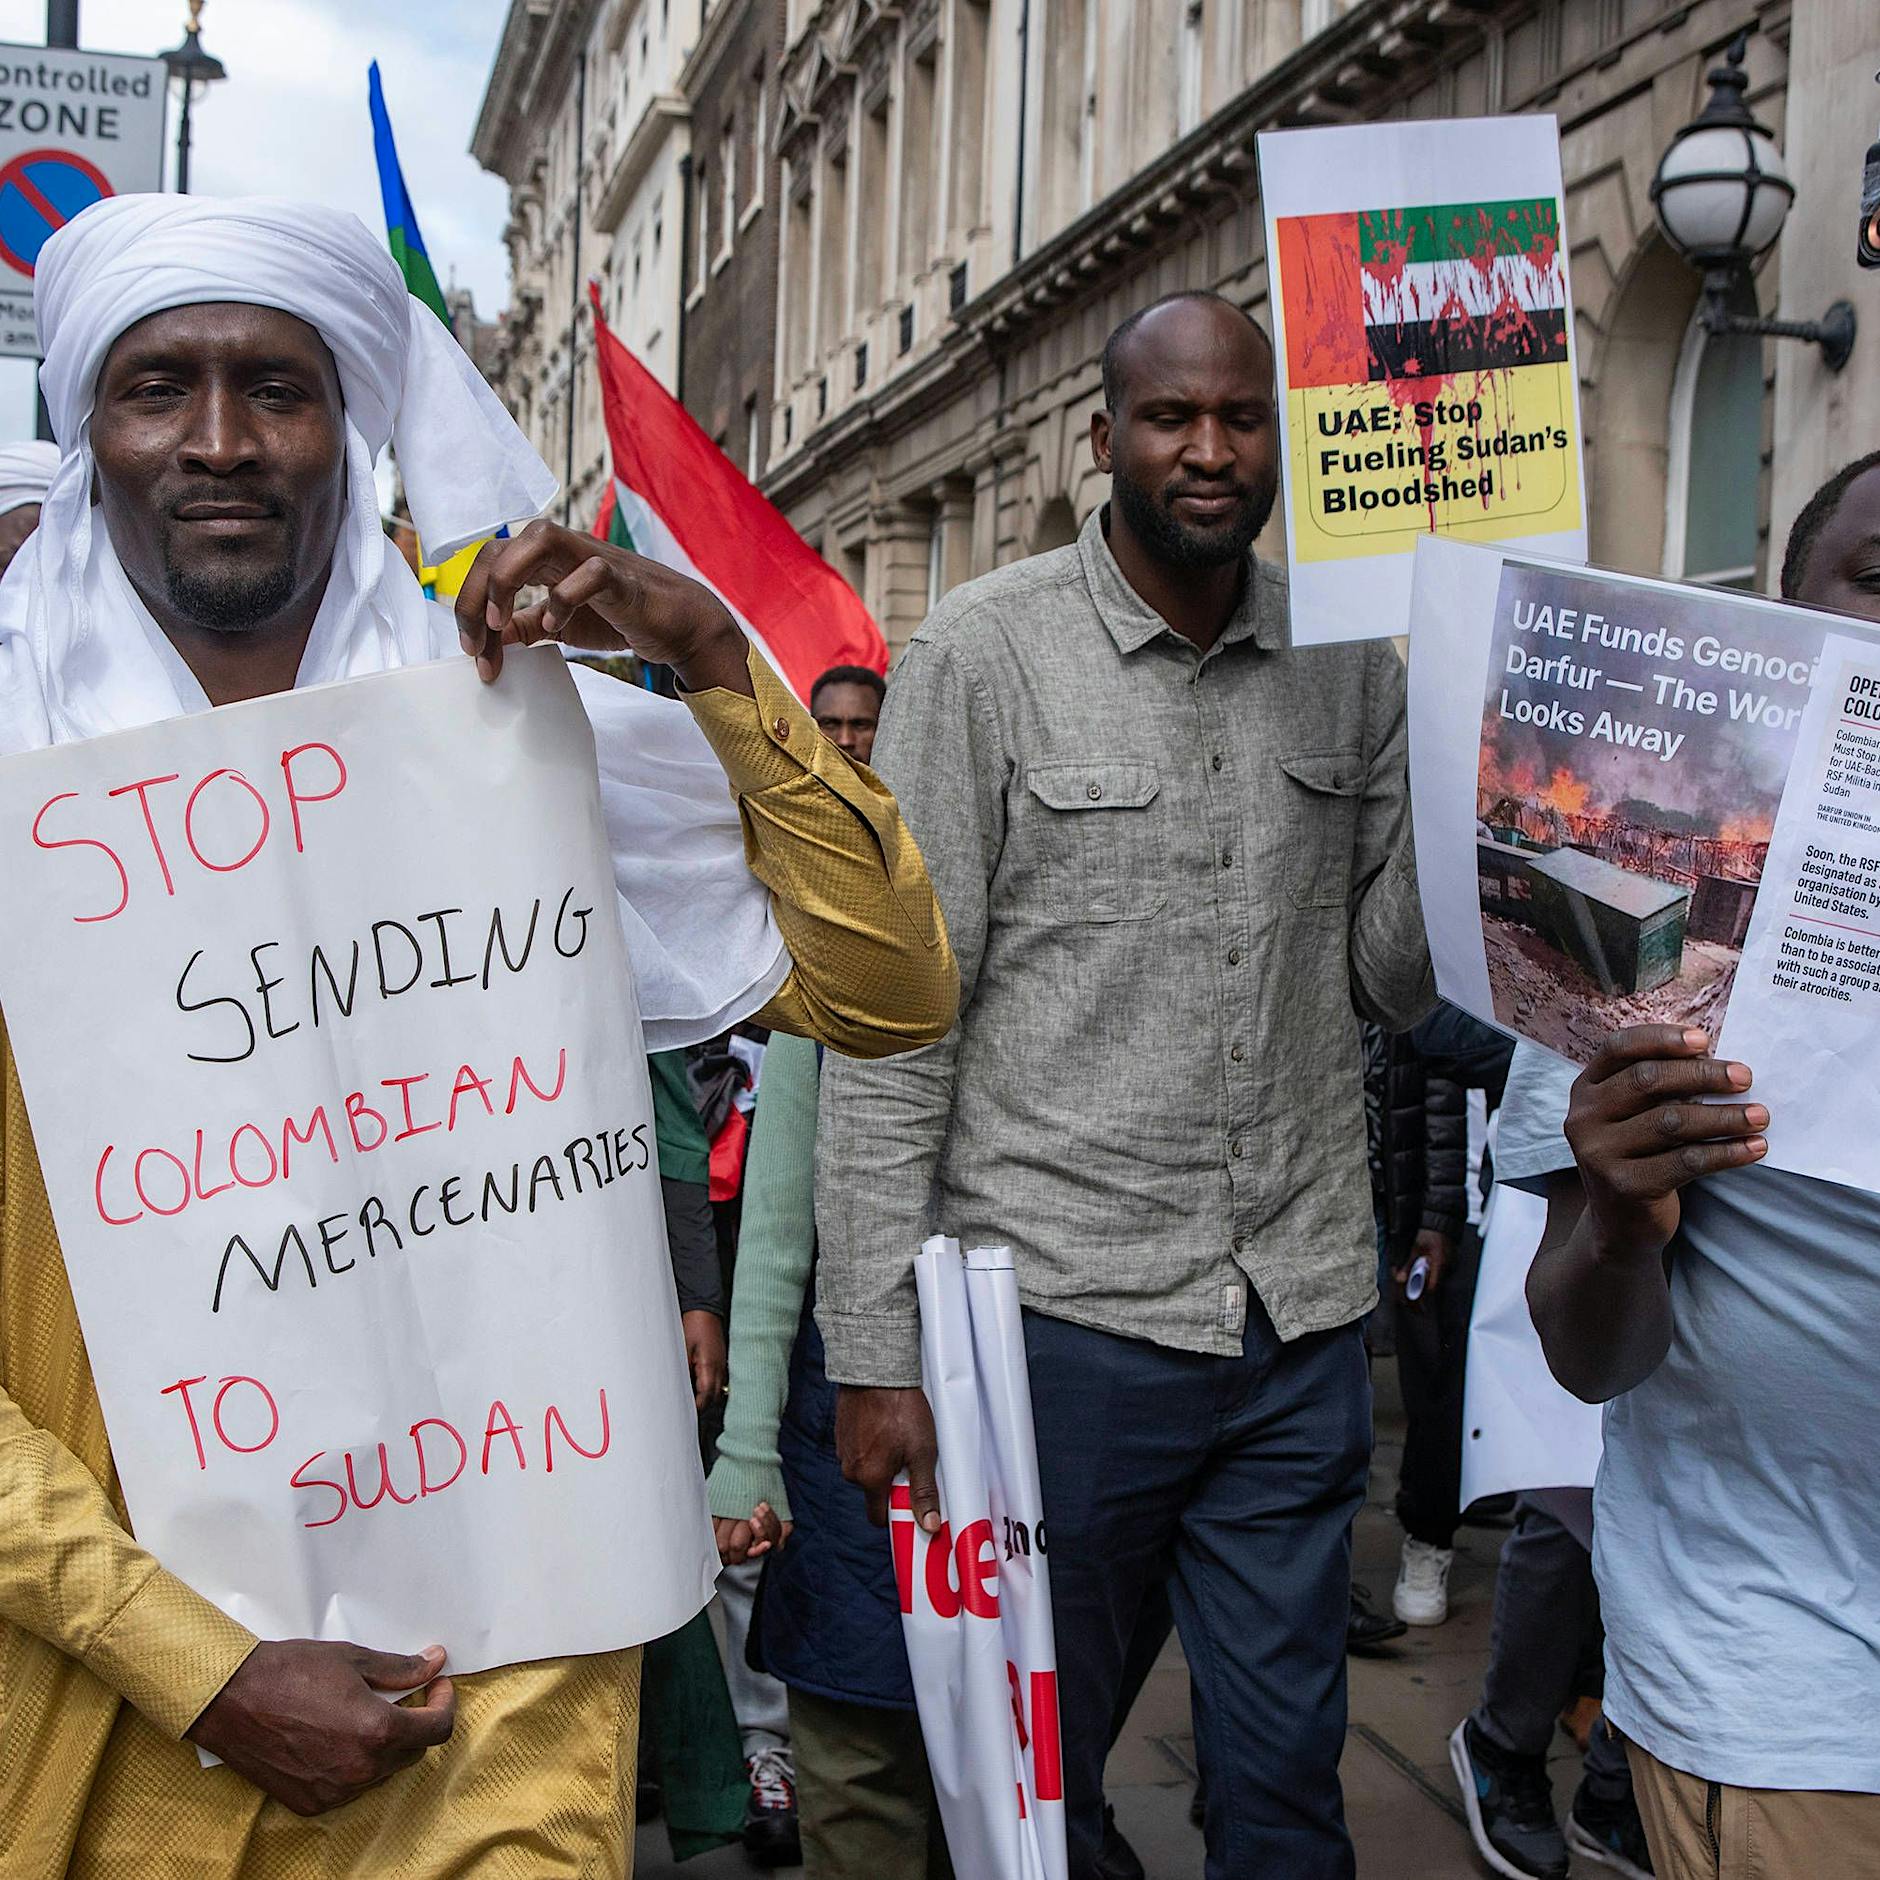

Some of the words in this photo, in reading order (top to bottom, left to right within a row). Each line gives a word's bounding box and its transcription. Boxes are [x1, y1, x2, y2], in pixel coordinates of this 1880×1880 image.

[0, 100, 119, 139] ZONE
[1318, 406, 1401, 437] UAE:
[1414, 400, 1482, 428] Stop
[1321, 440, 1447, 475] Fueling
[1457, 426, 1567, 460] Sudan’s
[1323, 470, 1493, 513] Bloodshed
[1513, 600, 1578, 639] UAE
[1581, 613, 1685, 660] Funds
[1505, 644, 1602, 691] Darfur
[1653, 674, 1718, 715] The
[1728, 689, 1806, 731] Wor
[1849, 675, 1880, 698] OPE
[1500, 689, 1585, 735] Looks
[1589, 711, 1686, 762] Away
[1829, 756, 1842, 768] for
[1833, 743, 1855, 757] Must
[1856, 748, 1877, 763] Stop
[1822, 782, 1851, 797] Sudan
[1826, 769, 1844, 781] RSF
[1844, 773, 1871, 789] Militia
[1817, 804, 1842, 816] DARFUR
[1843, 809, 1863, 821] UNION
[1863, 815, 1871, 823] IN
[1817, 812, 1828, 821] THE
[1829, 816, 1851, 827] UNITED
[32, 742, 347, 922] STOP
[1801, 860, 1863, 885] designated
[1863, 877, 1877, 888] as
[1806, 845, 1835, 864] Soon,
[1839, 853, 1857, 867] the
[1859, 857, 1880, 872] RSF
[1794, 890, 1830, 909] United
[1831, 899, 1869, 920] States.
[1797, 877, 1867, 902] organisation
[1781, 942, 1805, 958] than
[1808, 948, 1819, 961] to
[1820, 951, 1834, 965] be
[1784, 926, 1834, 948] Colombia
[1835, 938, 1846, 951] is
[1848, 941, 1880, 959] better
[177, 886, 593, 1063] SENDING
[1772, 973, 1798, 989] their
[1799, 982, 1852, 1002] atrocities.
[1777, 959, 1801, 974] with
[1802, 966, 1828, 981] such
[1830, 972, 1837, 982] a
[1839, 974, 1870, 991] group
[1872, 982, 1880, 993] a
[96, 1048, 565, 1225] COLOMBIAN
[213, 1124, 648, 1312] MERCENARIES
[160, 1375, 280, 1470] TO
[290, 1388, 611, 1528] SUDAN
